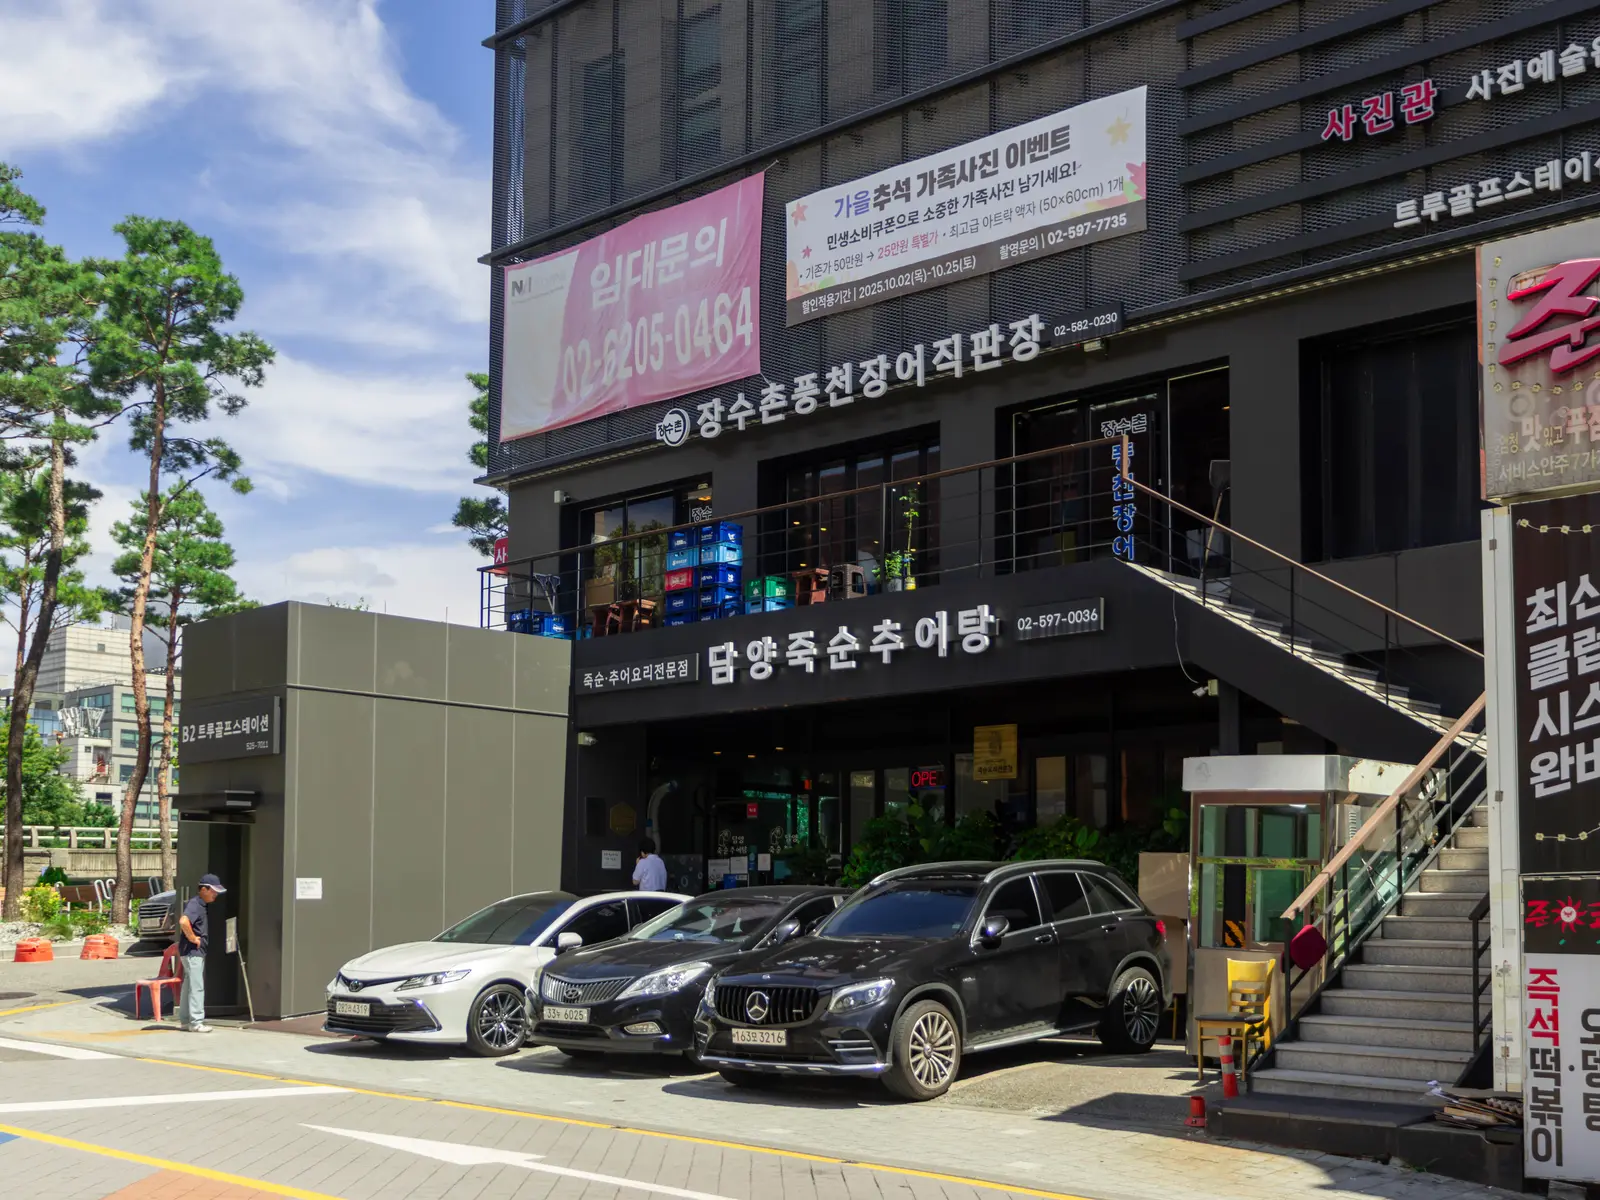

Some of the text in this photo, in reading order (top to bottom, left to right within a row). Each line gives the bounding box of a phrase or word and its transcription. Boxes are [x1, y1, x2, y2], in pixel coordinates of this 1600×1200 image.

[1321, 79, 1437, 141] 사진관
[916, 148, 999, 198] 가족사진
[1005, 124, 1071, 169] 이벤트
[827, 161, 1077, 250] 민생소비쿠폰으로 소중한 가족사진 남기세요!
[1393, 151, 1600, 229] 트루골프스테이
[805, 260, 832, 280] 기존가
[834, 252, 863, 273] 50만원
[877, 238, 909, 260] 25만원
[911, 230, 939, 250] 특별가
[949, 217, 980, 238] 최고급
[1015, 201, 1036, 219] 액자
[1107, 175, 1124, 193] 1개
[999, 212, 1128, 260] 촬영문의 02-597-7735
[590, 217, 728, 310] 임대문의
[802, 288, 852, 315] 할인적용기간
[1053, 311, 1118, 337] 02-582-0230
[696, 313, 1045, 439] 장수촌풍천장어직판장
[657, 419, 682, 437] 장수촌
[1100, 413, 1147, 438] 장수촌
[708, 604, 997, 686] 담양죽순추어탕
[1017, 608, 1098, 631] 02-597-0036
[182, 713, 269, 743] B2 트루골프스테이션
[564, 1009, 584, 1020] 6025
[759, 1031, 783, 1043] 3216
[1527, 967, 1563, 1168] 즉석 떡볶이
